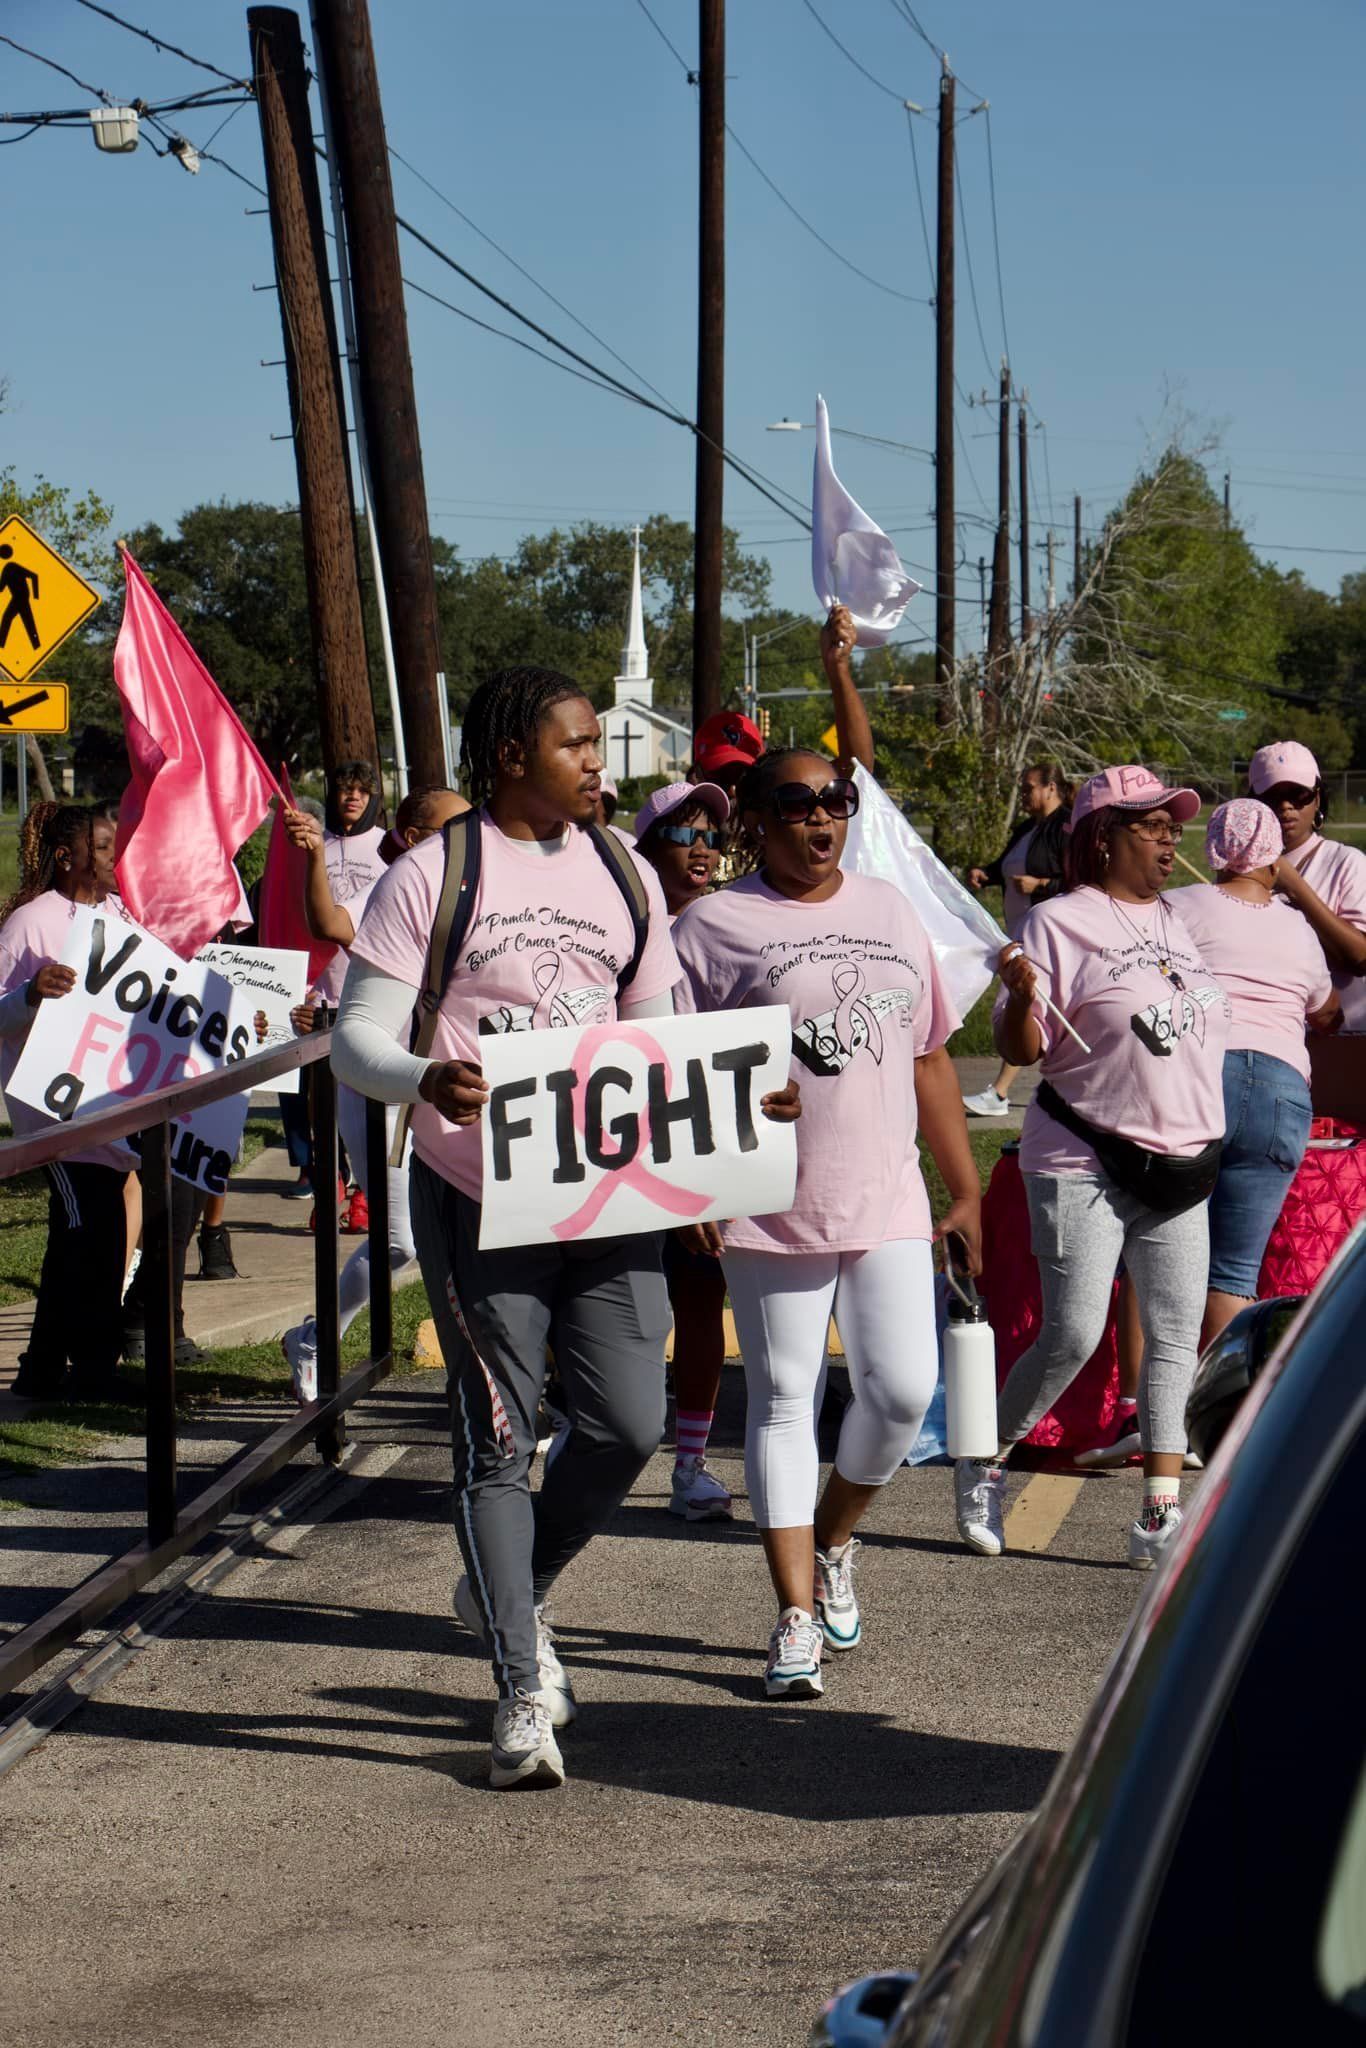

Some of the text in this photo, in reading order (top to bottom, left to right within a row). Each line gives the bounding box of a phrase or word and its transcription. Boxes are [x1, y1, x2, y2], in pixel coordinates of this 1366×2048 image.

[485, 907, 536, 934] Pamela
[538, 907, 609, 938] Thompson
[220, 951, 277, 973] Thompson
[466, 936, 513, 971] Breast
[514, 932, 557, 951] Cancer
[778, 937, 824, 952] Pamela
[825, 935, 893, 949] Thompson
[232, 971, 293, 999] Foundation
[766, 953, 804, 988] Breast
[809, 951, 849, 964] Cancer
[84, 918, 250, 1067] Voices
[489, 1041, 770, 1184] FIGHT
[125, 1121, 231, 1194] ure
